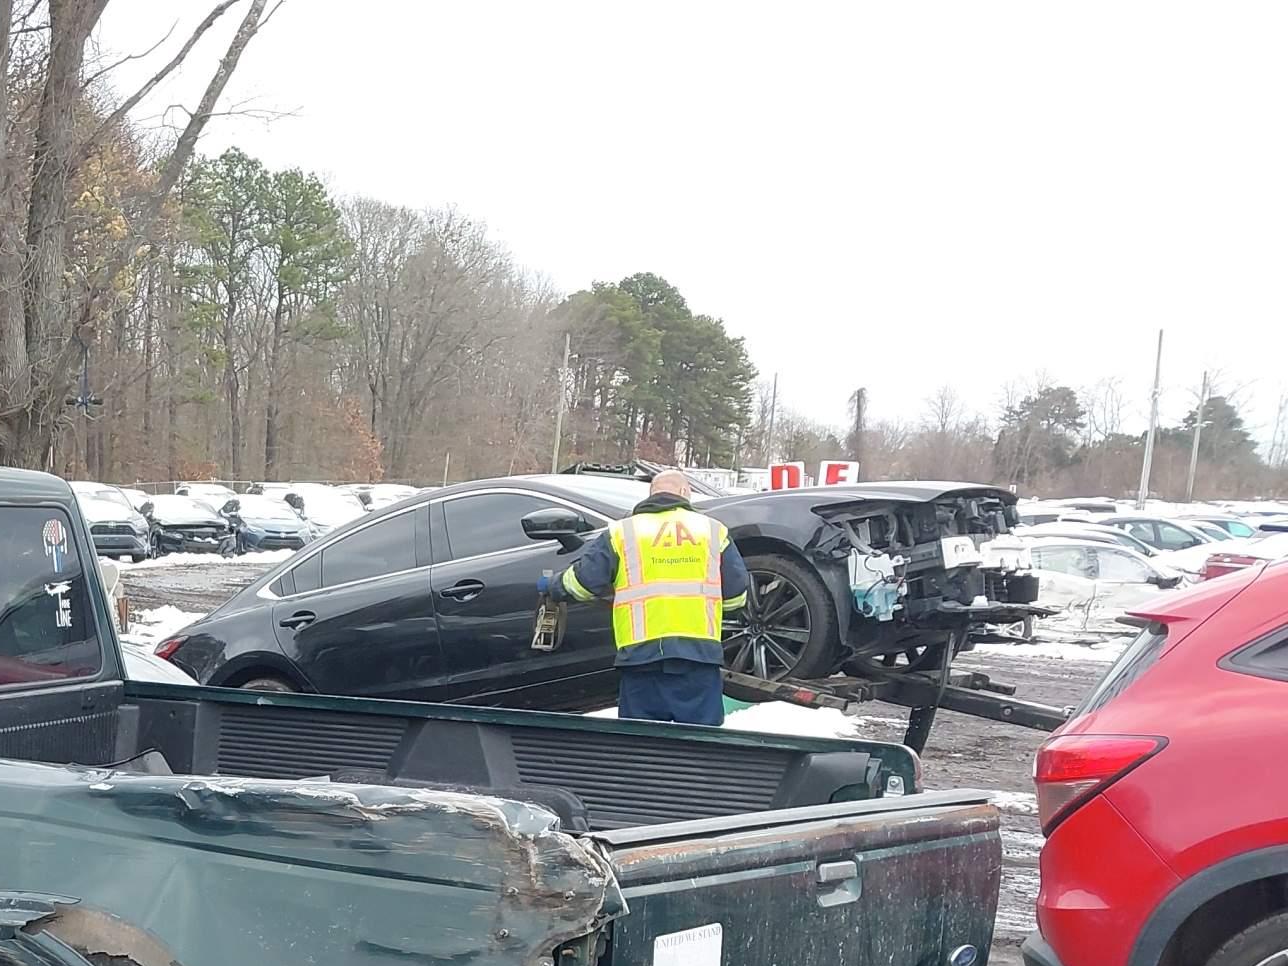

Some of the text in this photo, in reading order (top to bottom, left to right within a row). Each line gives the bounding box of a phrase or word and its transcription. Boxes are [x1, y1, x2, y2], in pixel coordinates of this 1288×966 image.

[651, 556, 701, 565] Transportation
[56, 609, 72, 627] LINE
[655, 926, 721, 949] UNITED WE STAND
